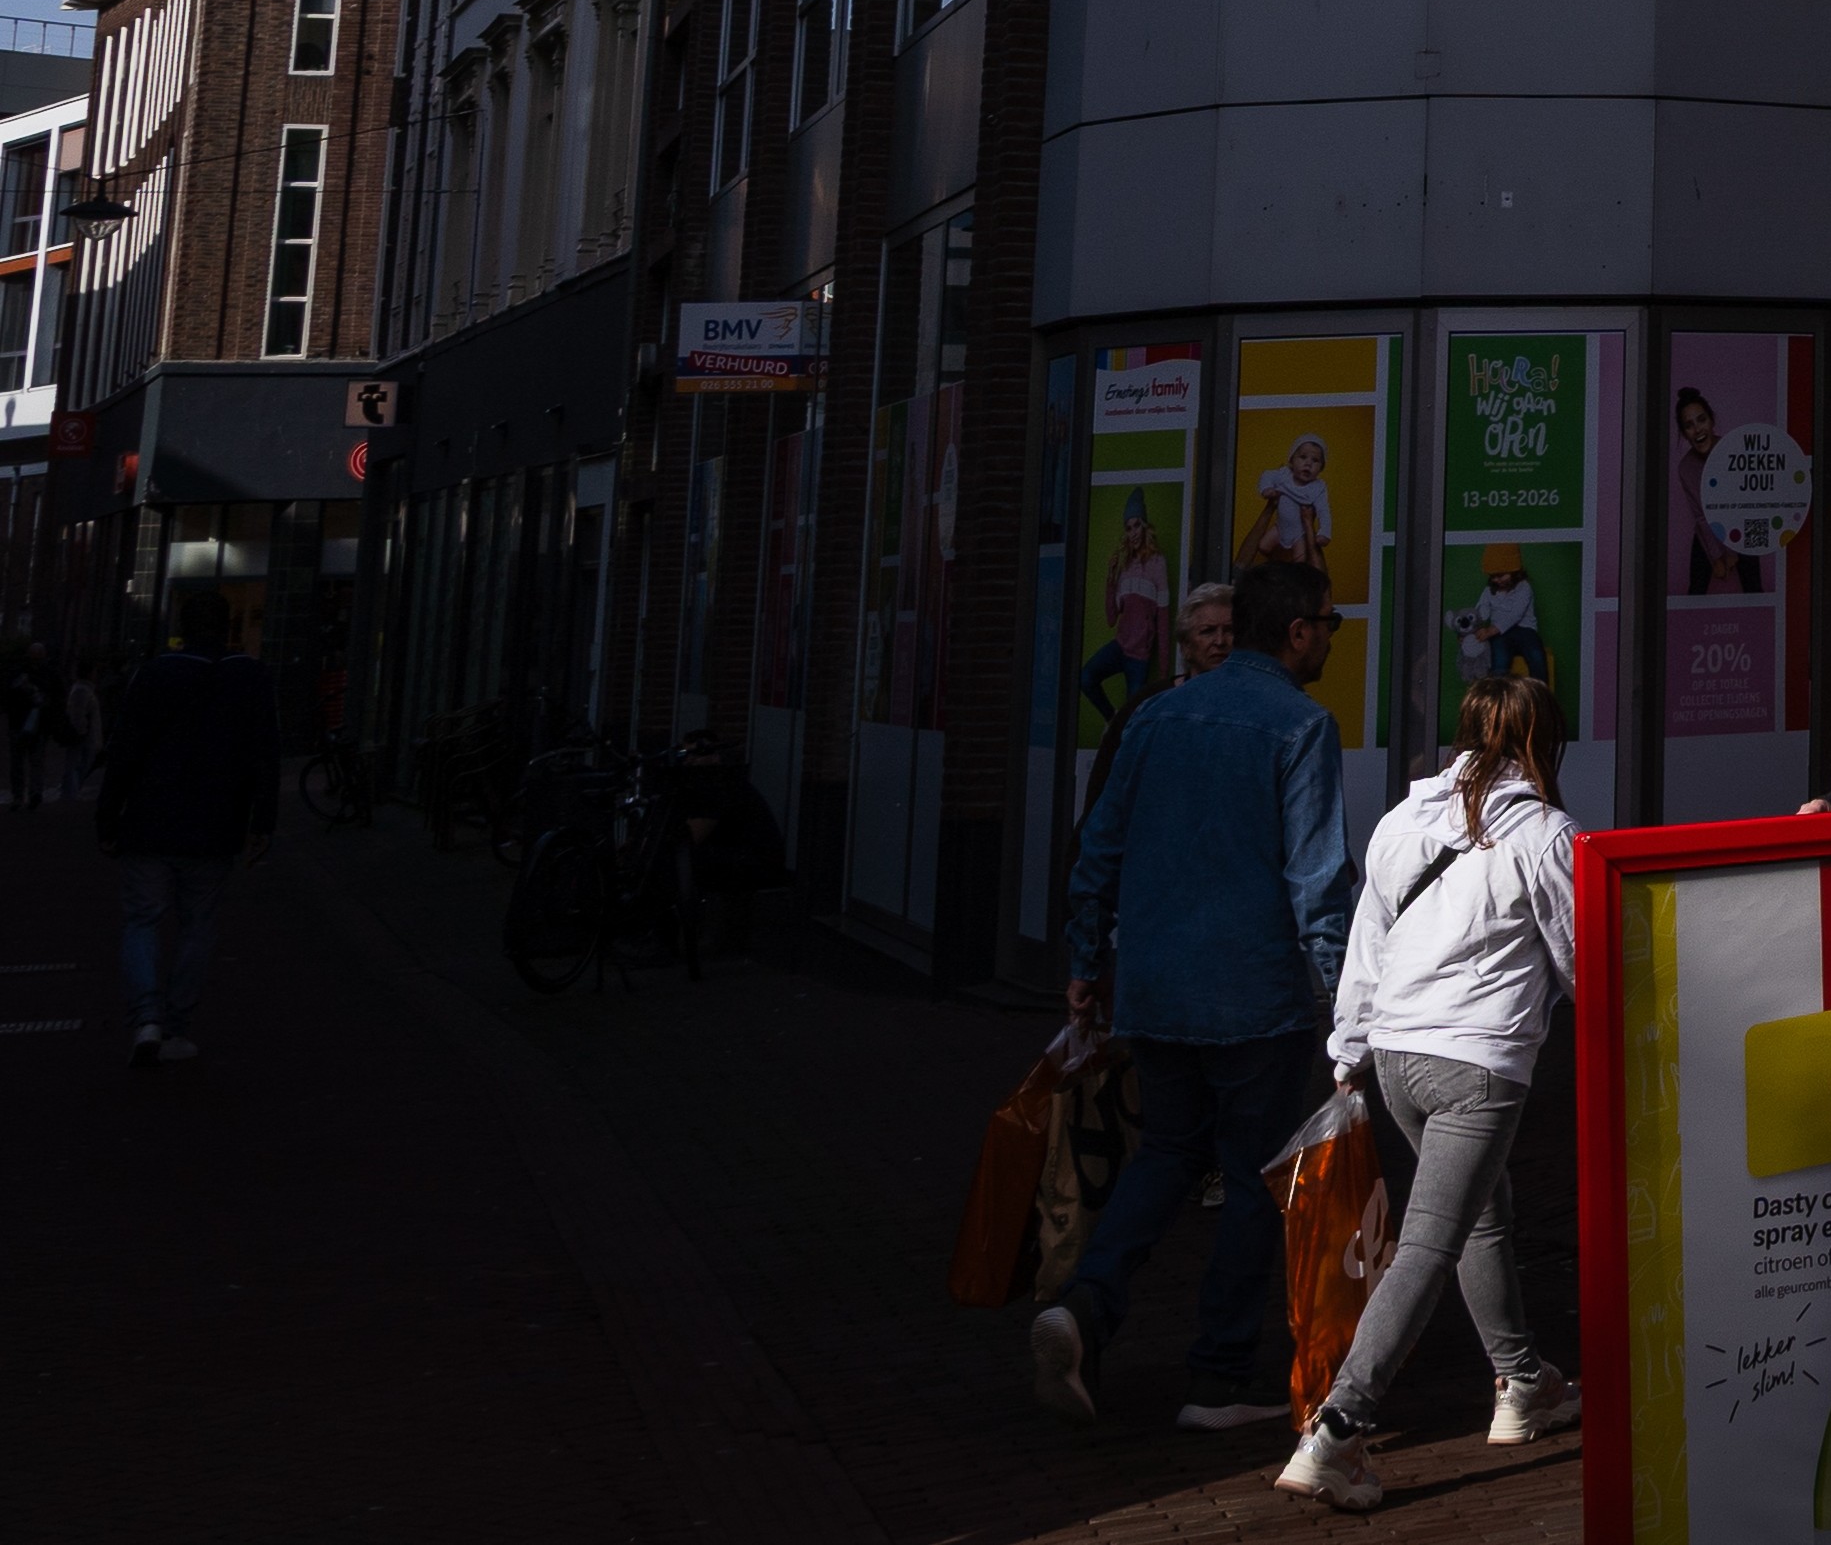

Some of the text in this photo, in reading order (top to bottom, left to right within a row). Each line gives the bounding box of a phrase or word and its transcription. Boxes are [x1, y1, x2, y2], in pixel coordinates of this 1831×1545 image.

[704, 319, 763, 341] BMV
[693, 353, 788, 375] VERHUURD
[1152, 376, 1189, 399] family
[1743, 434, 1770, 451] WIJ
[1728, 454, 1785, 471] ZOEKEN
[1739, 474, 1774, 491] JOU!
[1462, 489, 1560, 507] 13-03-2026
[1690, 642, 1752, 674] 20%
[1753, 1193, 1818, 1218] Dasty
[1753, 1222, 1818, 1250] spray
[1754, 1255, 1813, 1275] citroen
[1754, 1284, 1776, 1300] alle
[1738, 1334, 1796, 1374] lekker
[1751, 1360, 1796, 1403] slim!
